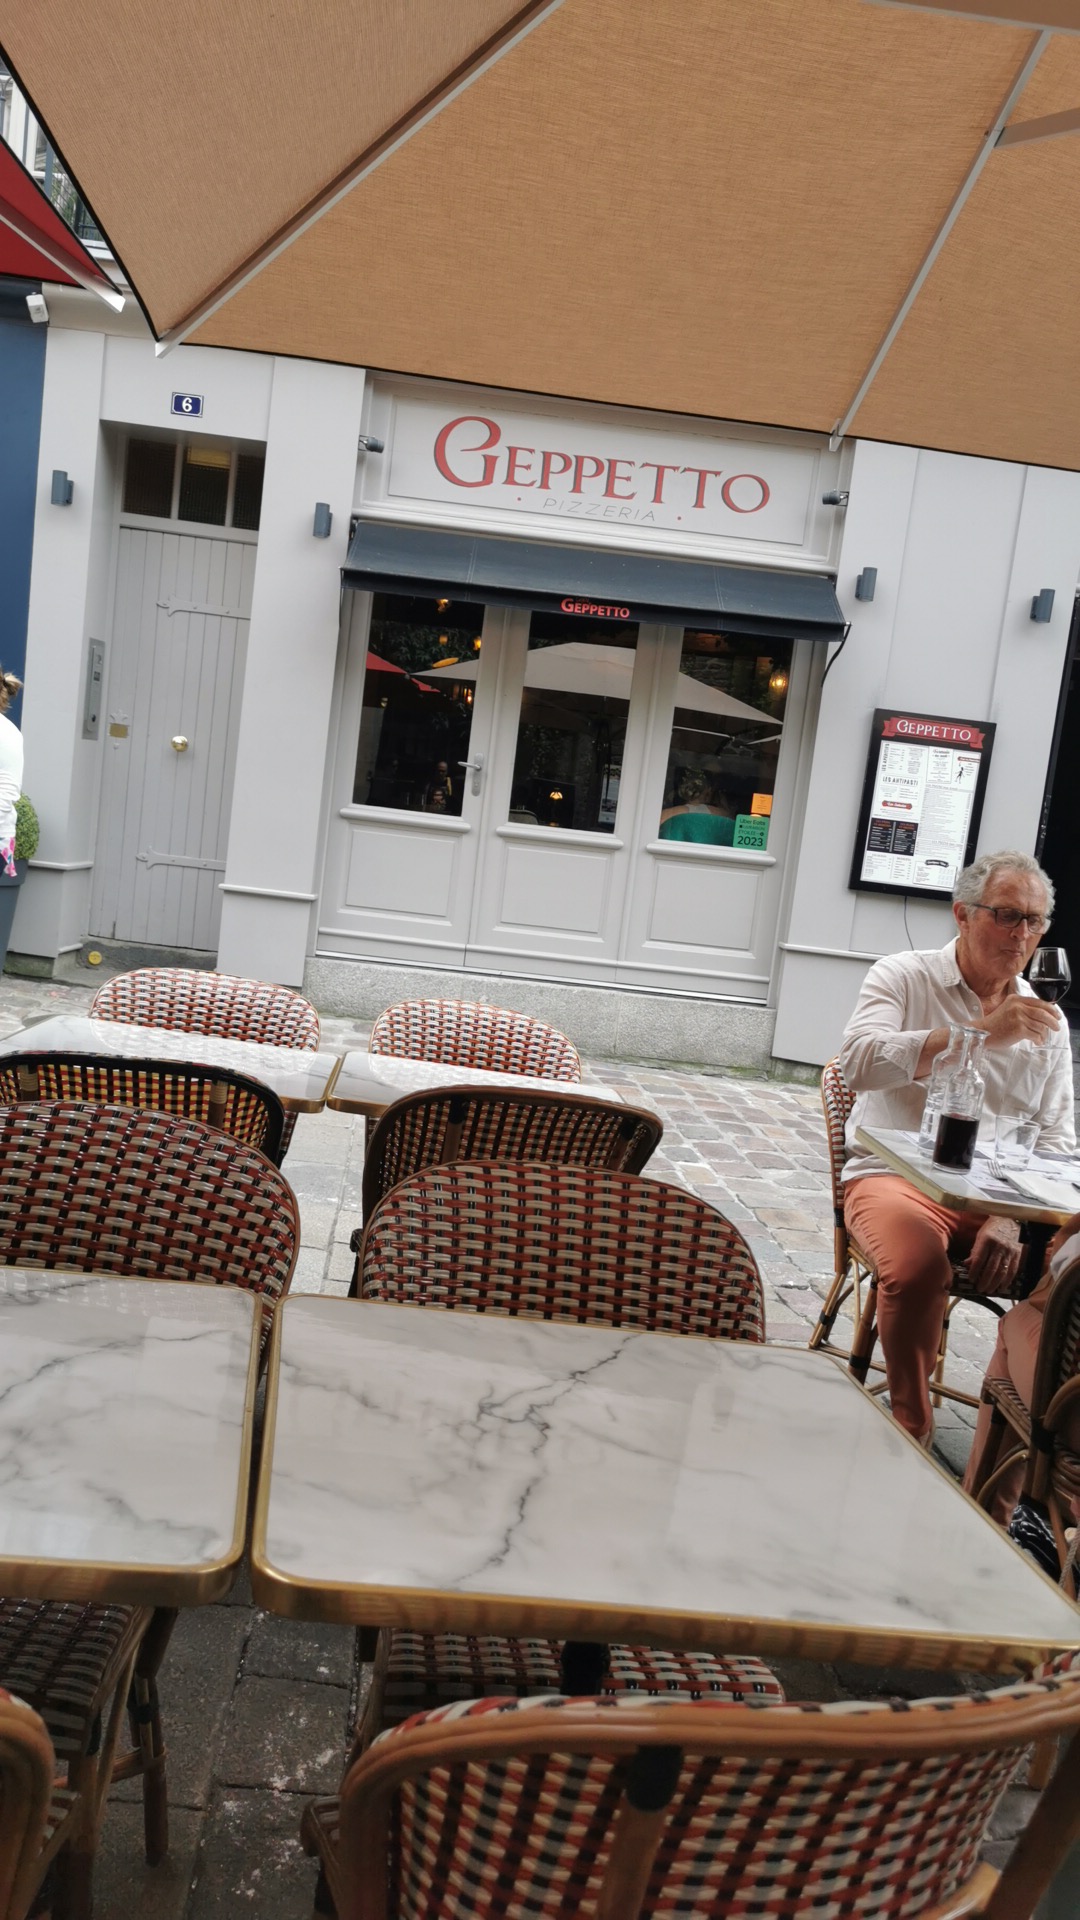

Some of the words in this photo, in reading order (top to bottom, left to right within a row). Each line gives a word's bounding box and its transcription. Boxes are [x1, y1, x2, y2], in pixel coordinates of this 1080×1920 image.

[182, 397, 193, 412] 6
[433, 415, 771, 514] GEPPETTO
[542, 497, 656, 523] PIZZERIA
[560, 597, 630, 619] GEPPETTO
[896, 720, 971, 741] GEPPETTO
[737, 835, 763, 847] 2023
